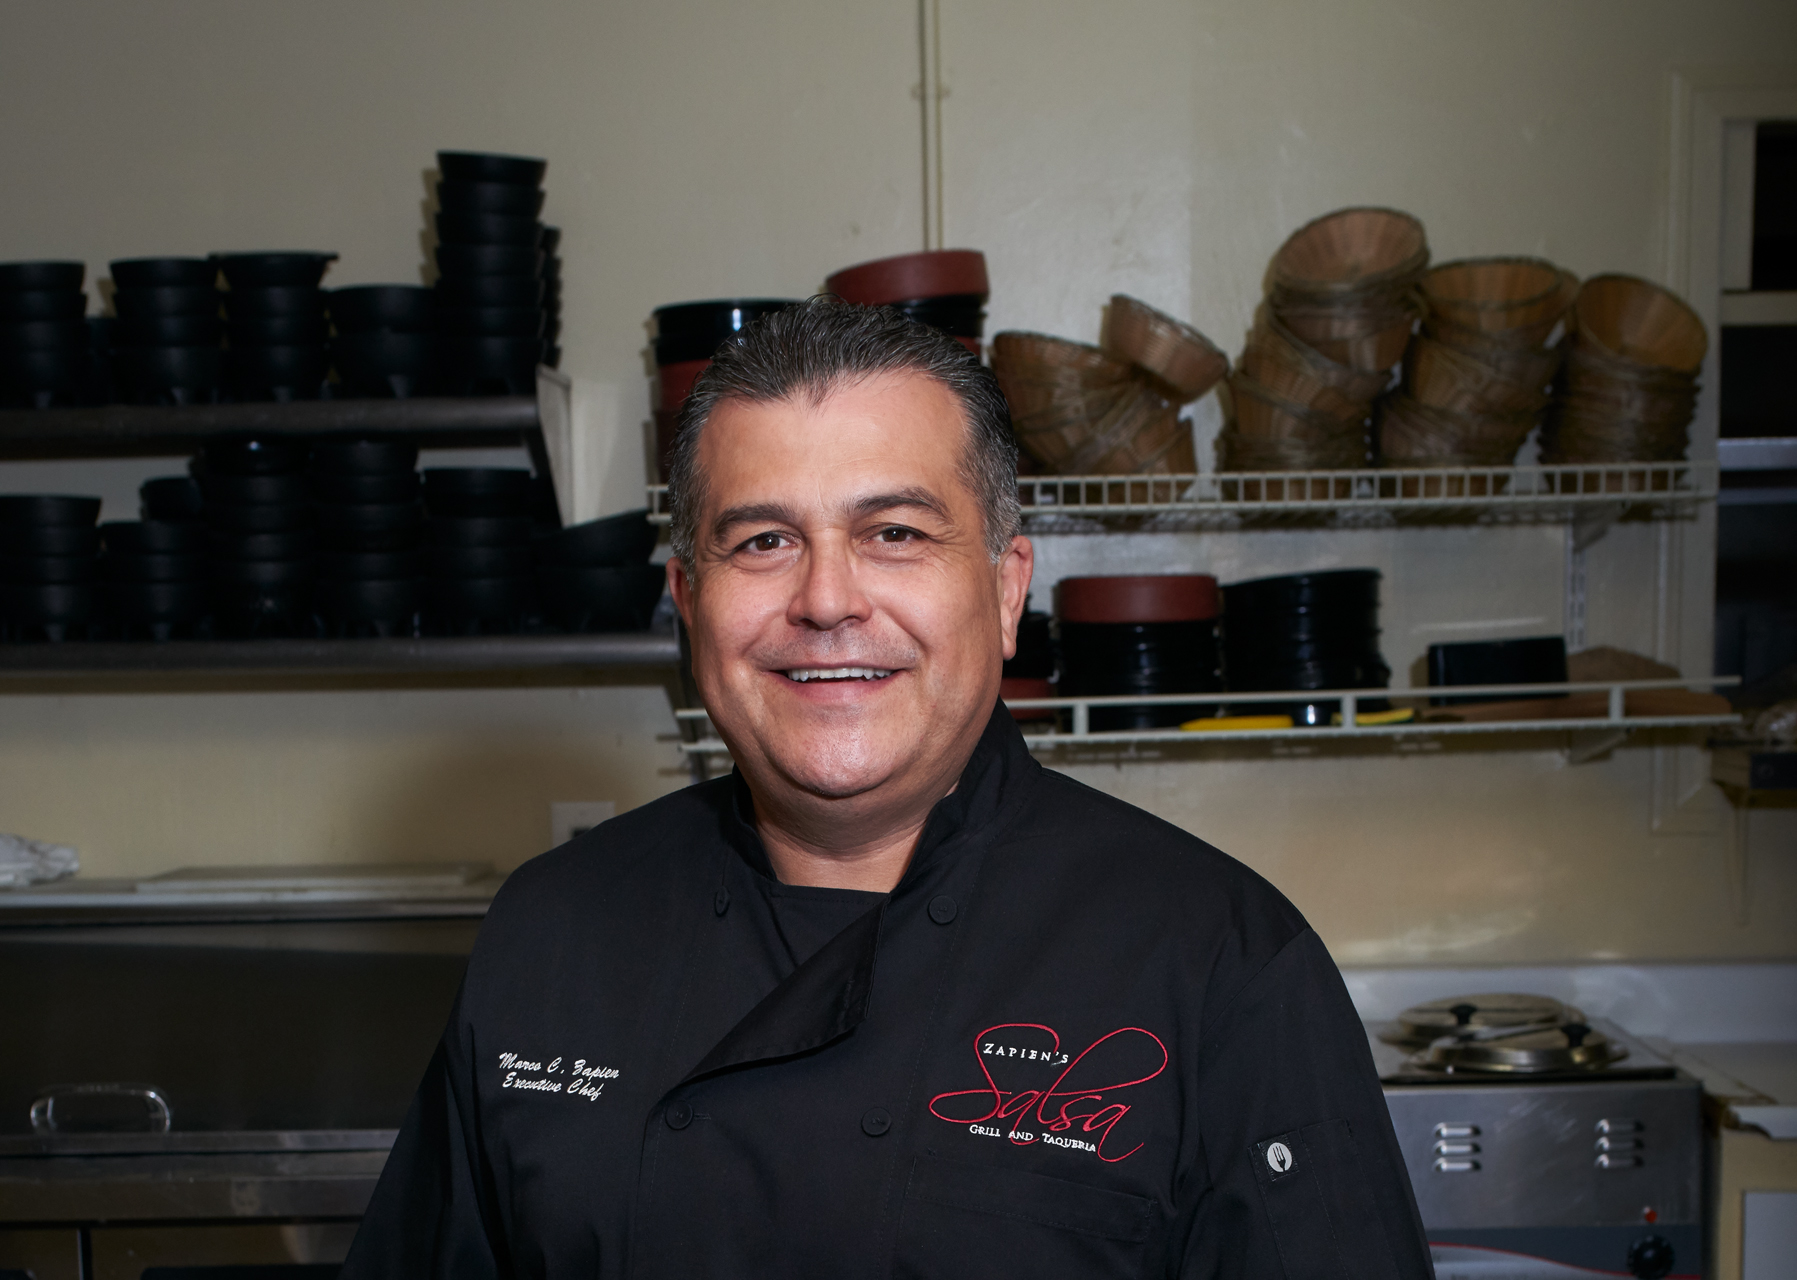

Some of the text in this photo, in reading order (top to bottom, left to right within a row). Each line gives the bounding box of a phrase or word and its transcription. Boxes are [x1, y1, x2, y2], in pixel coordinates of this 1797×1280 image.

[499, 1052, 541, 1071] Marco
[572, 1059, 619, 1081] Zapien
[983, 1043, 1069, 1064] ZAPIEN'S
[502, 1072, 604, 1101] Executive Chef
[928, 1022, 1168, 1162] Salsa
[969, 1124, 1096, 1152] GRILL AND TAQUERIA
